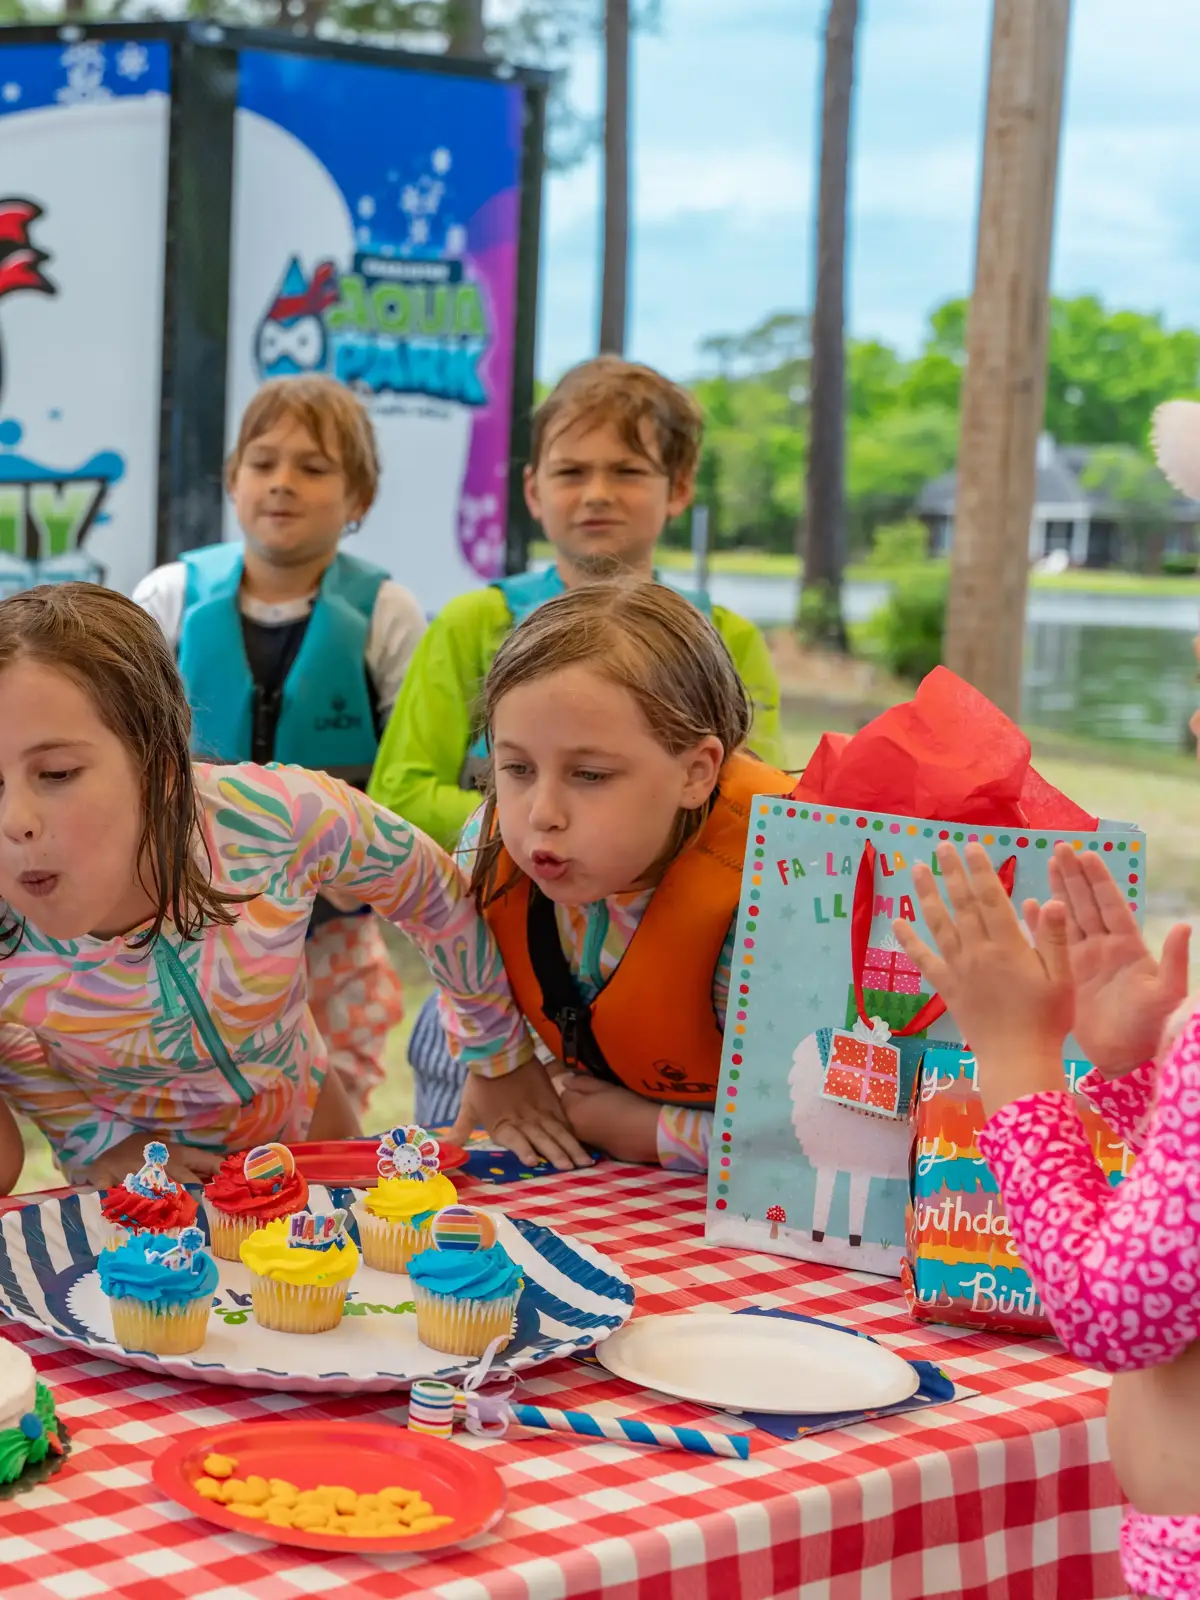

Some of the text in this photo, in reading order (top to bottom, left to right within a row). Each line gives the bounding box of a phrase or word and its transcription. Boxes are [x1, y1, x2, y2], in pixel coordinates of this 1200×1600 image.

[813, 893, 916, 924] LLMA
[291, 1211, 347, 1240] HAPPY
[914, 1195, 1019, 1257] irthda
